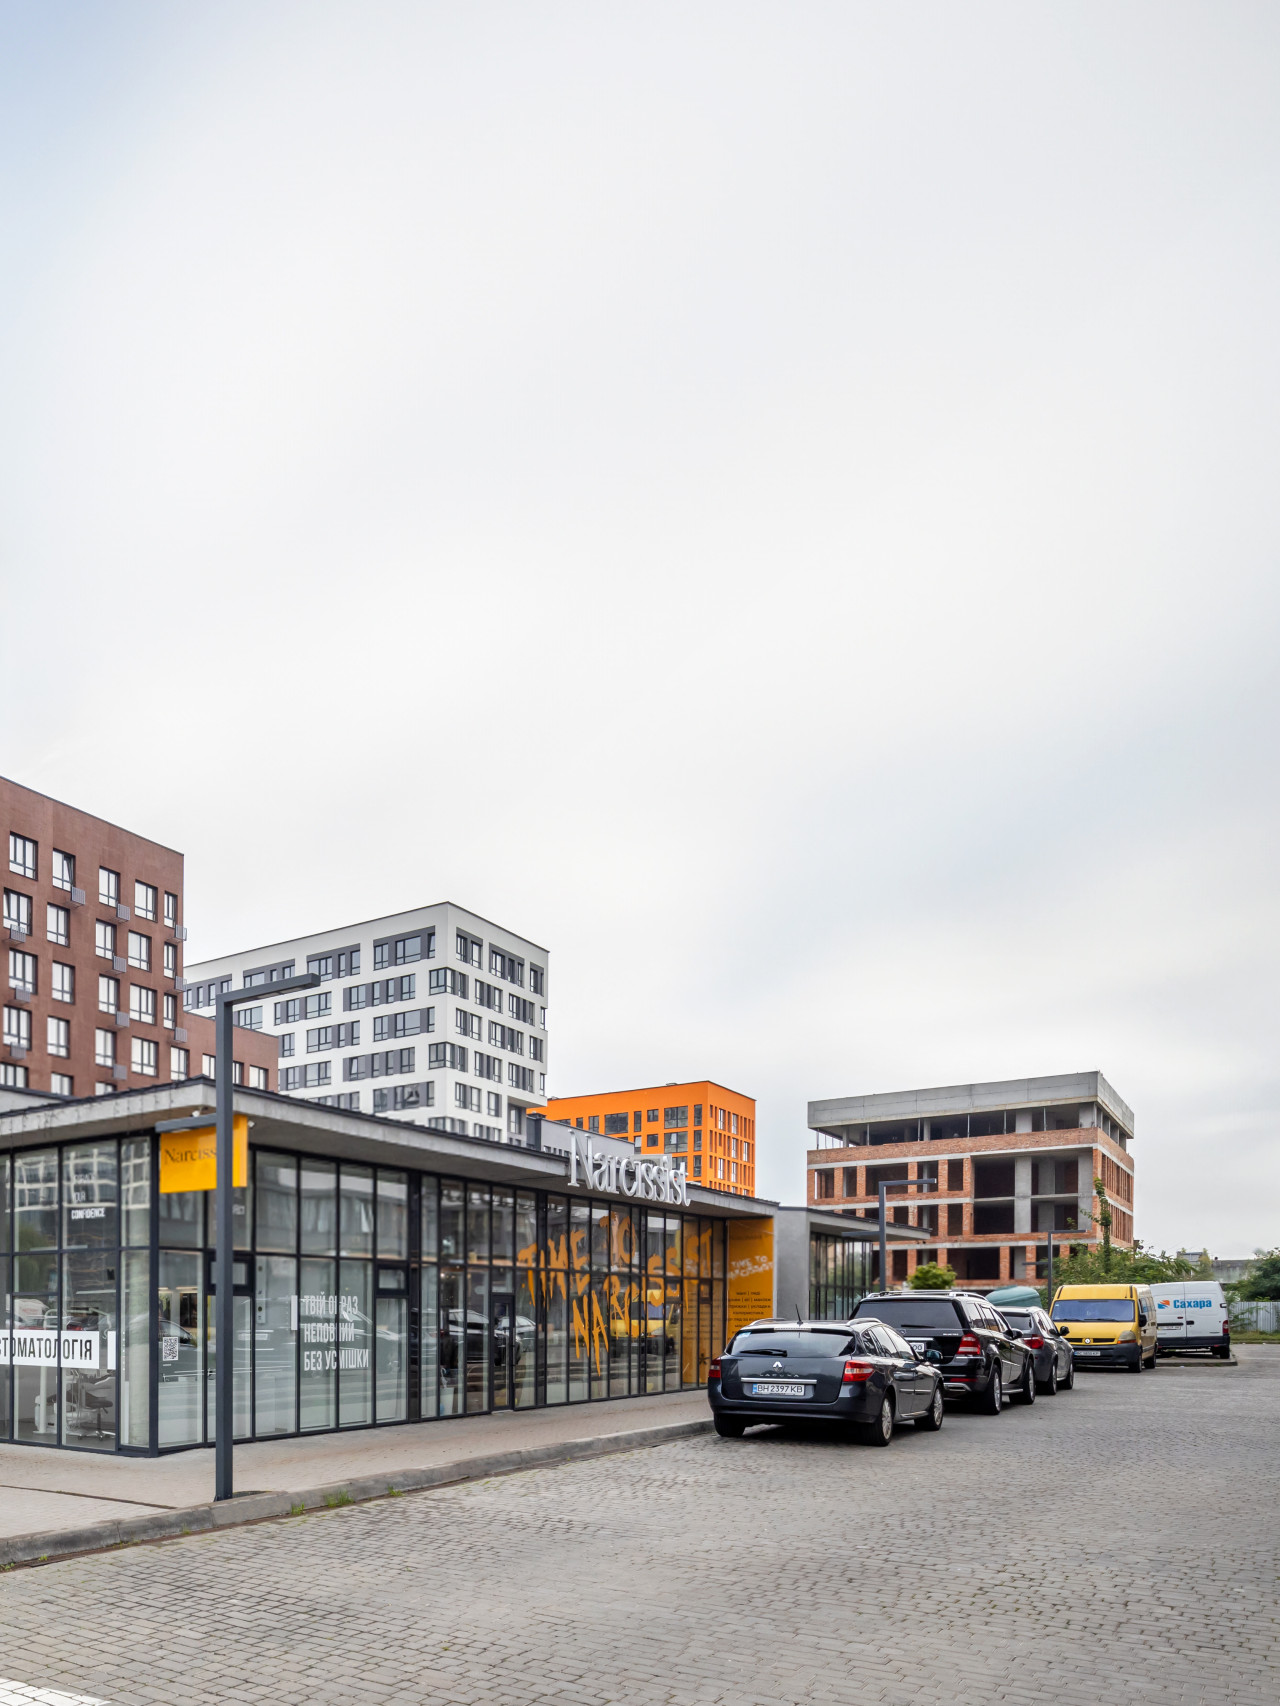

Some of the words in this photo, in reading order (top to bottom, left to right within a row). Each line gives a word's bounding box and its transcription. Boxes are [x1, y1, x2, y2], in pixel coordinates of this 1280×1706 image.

[164, 1148, 217, 1165] Narciss
[567, 1128, 692, 1207] Narcissist
[71, 1207, 106, 1220] CONFIDENCE
[303, 1291, 326, 1316] ТВІЙ
[1173, 1299, 1212, 1310] Сахара
[303, 1350, 323, 1371] БЕЗ
[757, 1384, 769, 1392] BH
